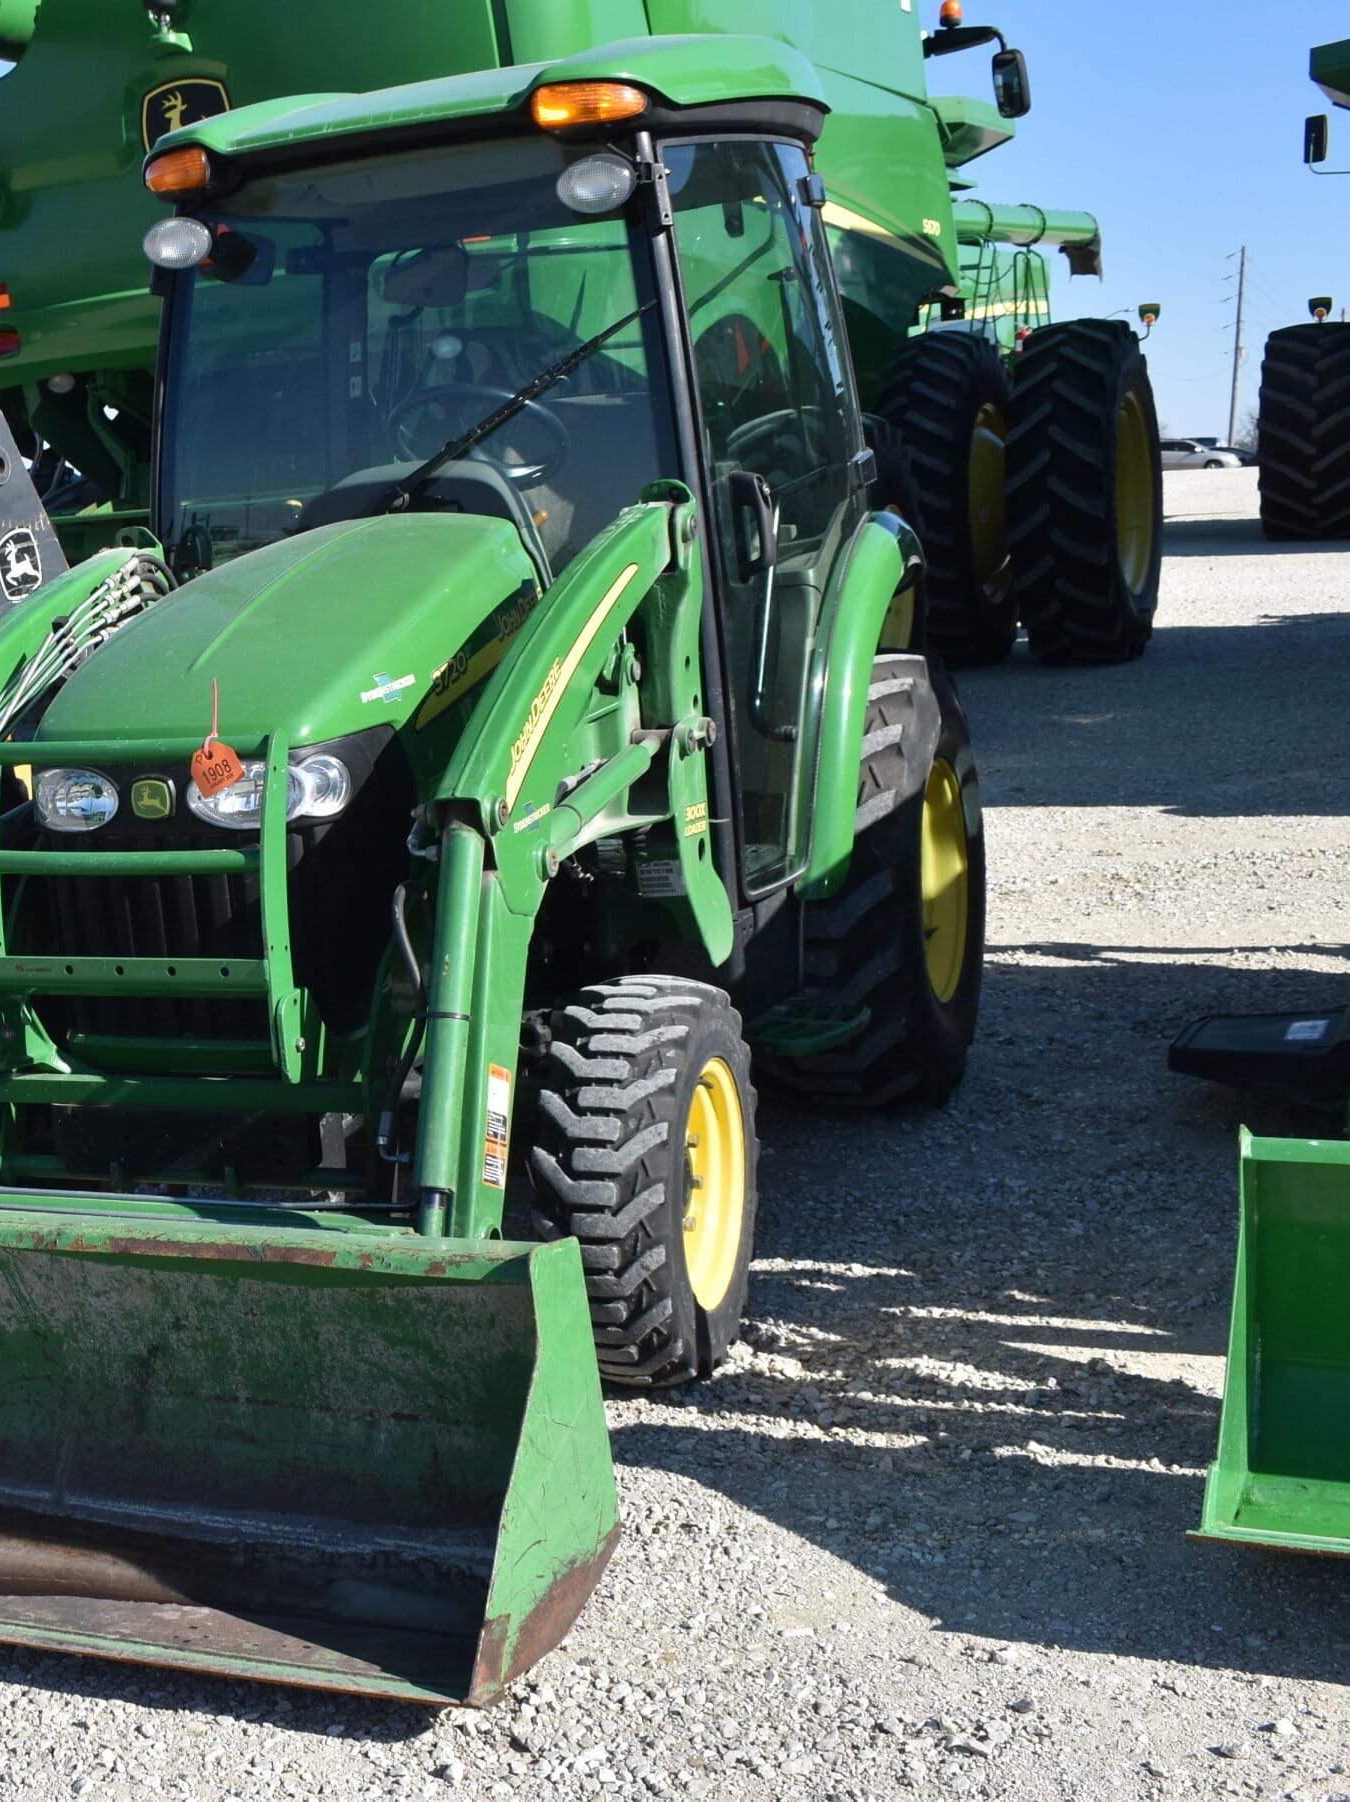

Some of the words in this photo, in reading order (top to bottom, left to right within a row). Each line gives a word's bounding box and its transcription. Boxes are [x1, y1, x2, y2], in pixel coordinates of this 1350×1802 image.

[510, 713, 535, 776] JOHN
[531, 656, 563, 724] DEERE
[202, 759, 232, 785] 1908
[685, 801, 707, 822] 300X
[684, 821, 707, 838] LOADER
